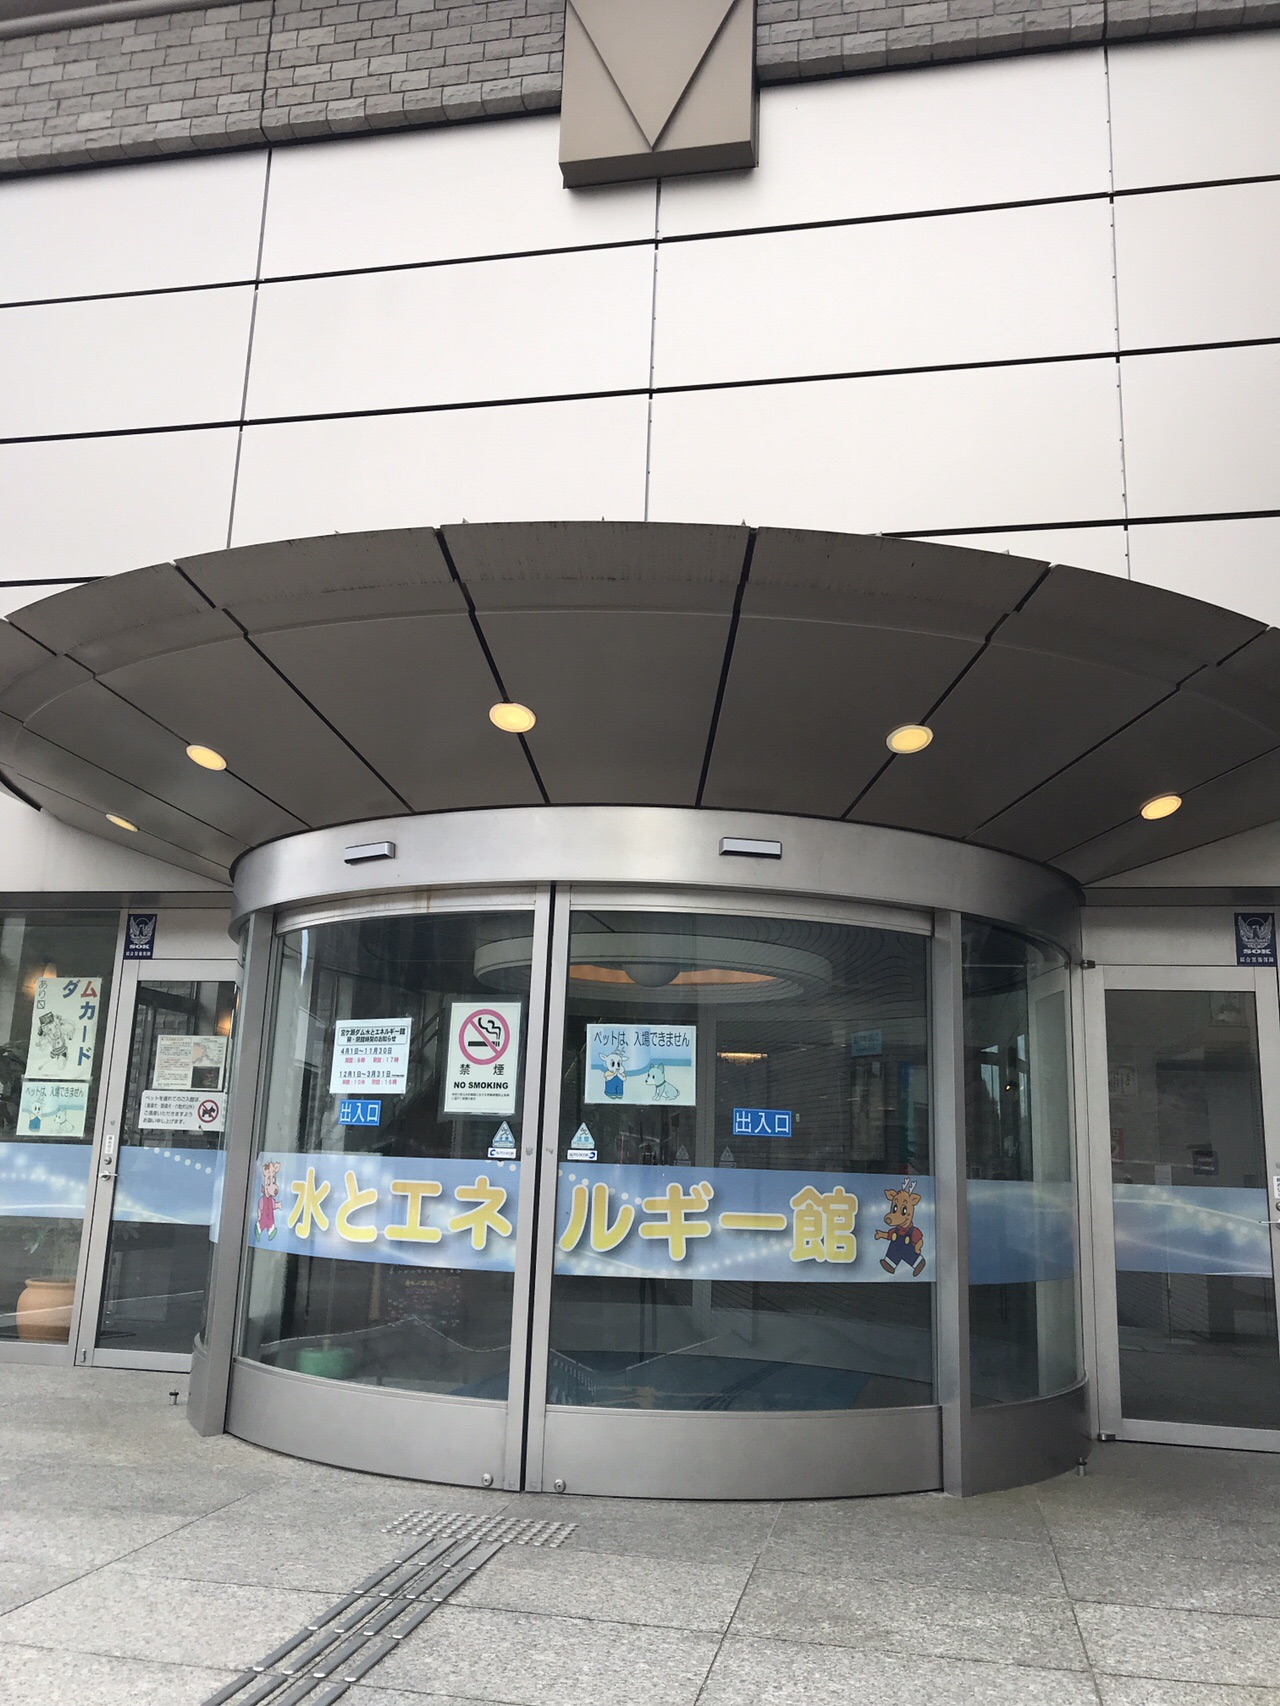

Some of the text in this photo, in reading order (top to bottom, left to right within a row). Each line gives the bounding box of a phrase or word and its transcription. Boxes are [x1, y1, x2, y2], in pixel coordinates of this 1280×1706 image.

[593, 1031, 691, 1048] ペットは、入場できません
[453, 1081, 509, 1090] NO SMOKING
[340, 1102, 379, 1122] 出入口
[735, 1111, 789, 1134] 出入口
[287, 1167, 858, 1264] 水とエネ ルギー館
